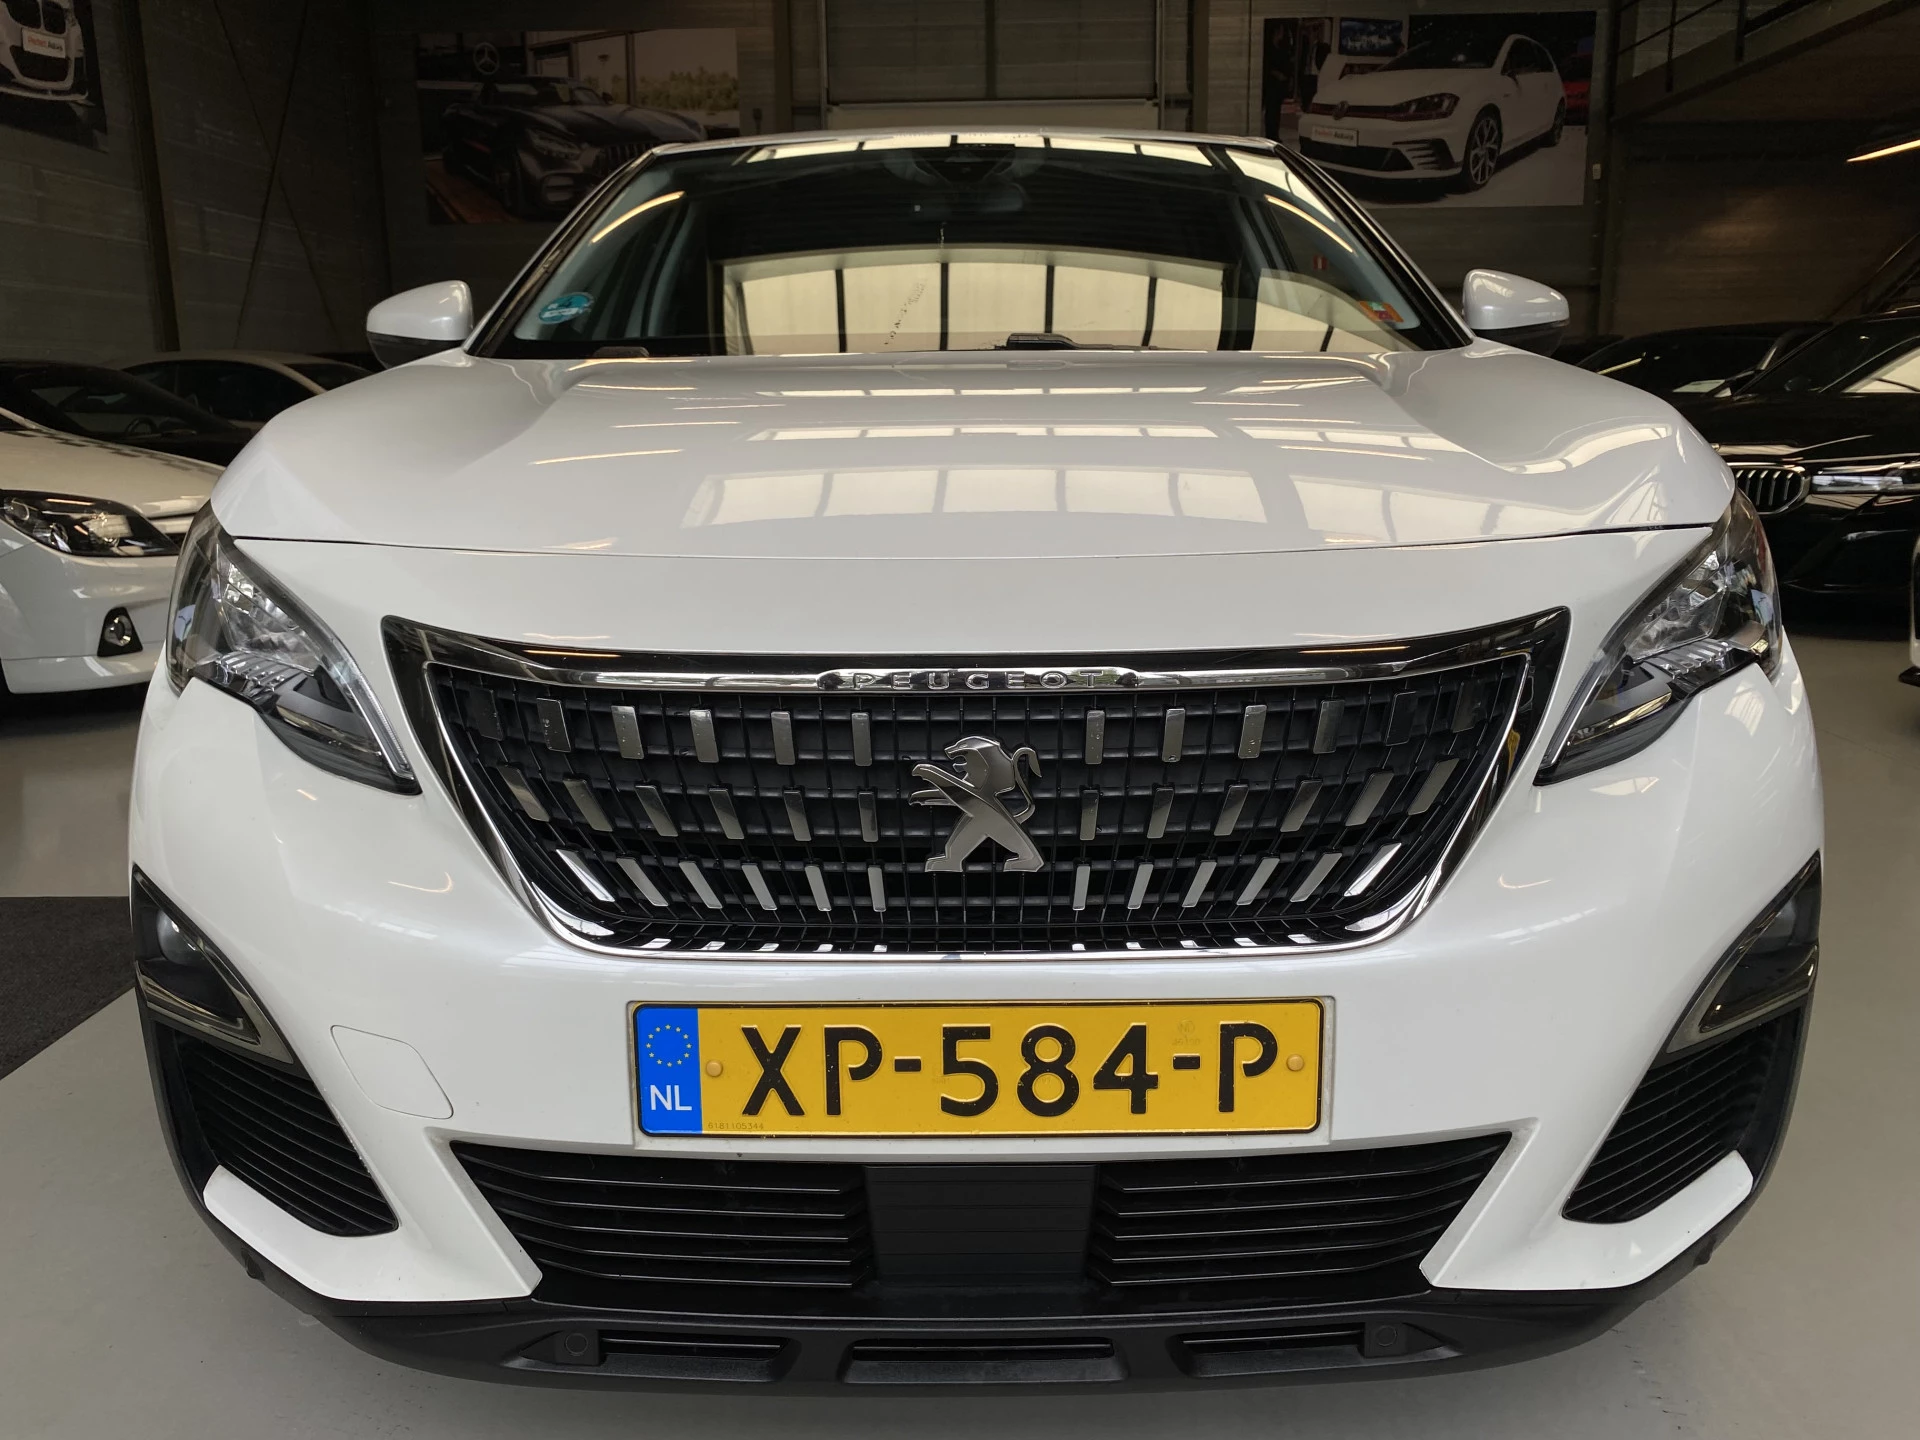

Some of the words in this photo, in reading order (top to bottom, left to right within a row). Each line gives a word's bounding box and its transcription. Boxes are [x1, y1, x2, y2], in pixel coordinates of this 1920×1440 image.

[853, 671, 1103, 690] PEUGEOT
[741, 1022, 1278, 1117] XP-584-P
[650, 1084, 692, 1110] NL
